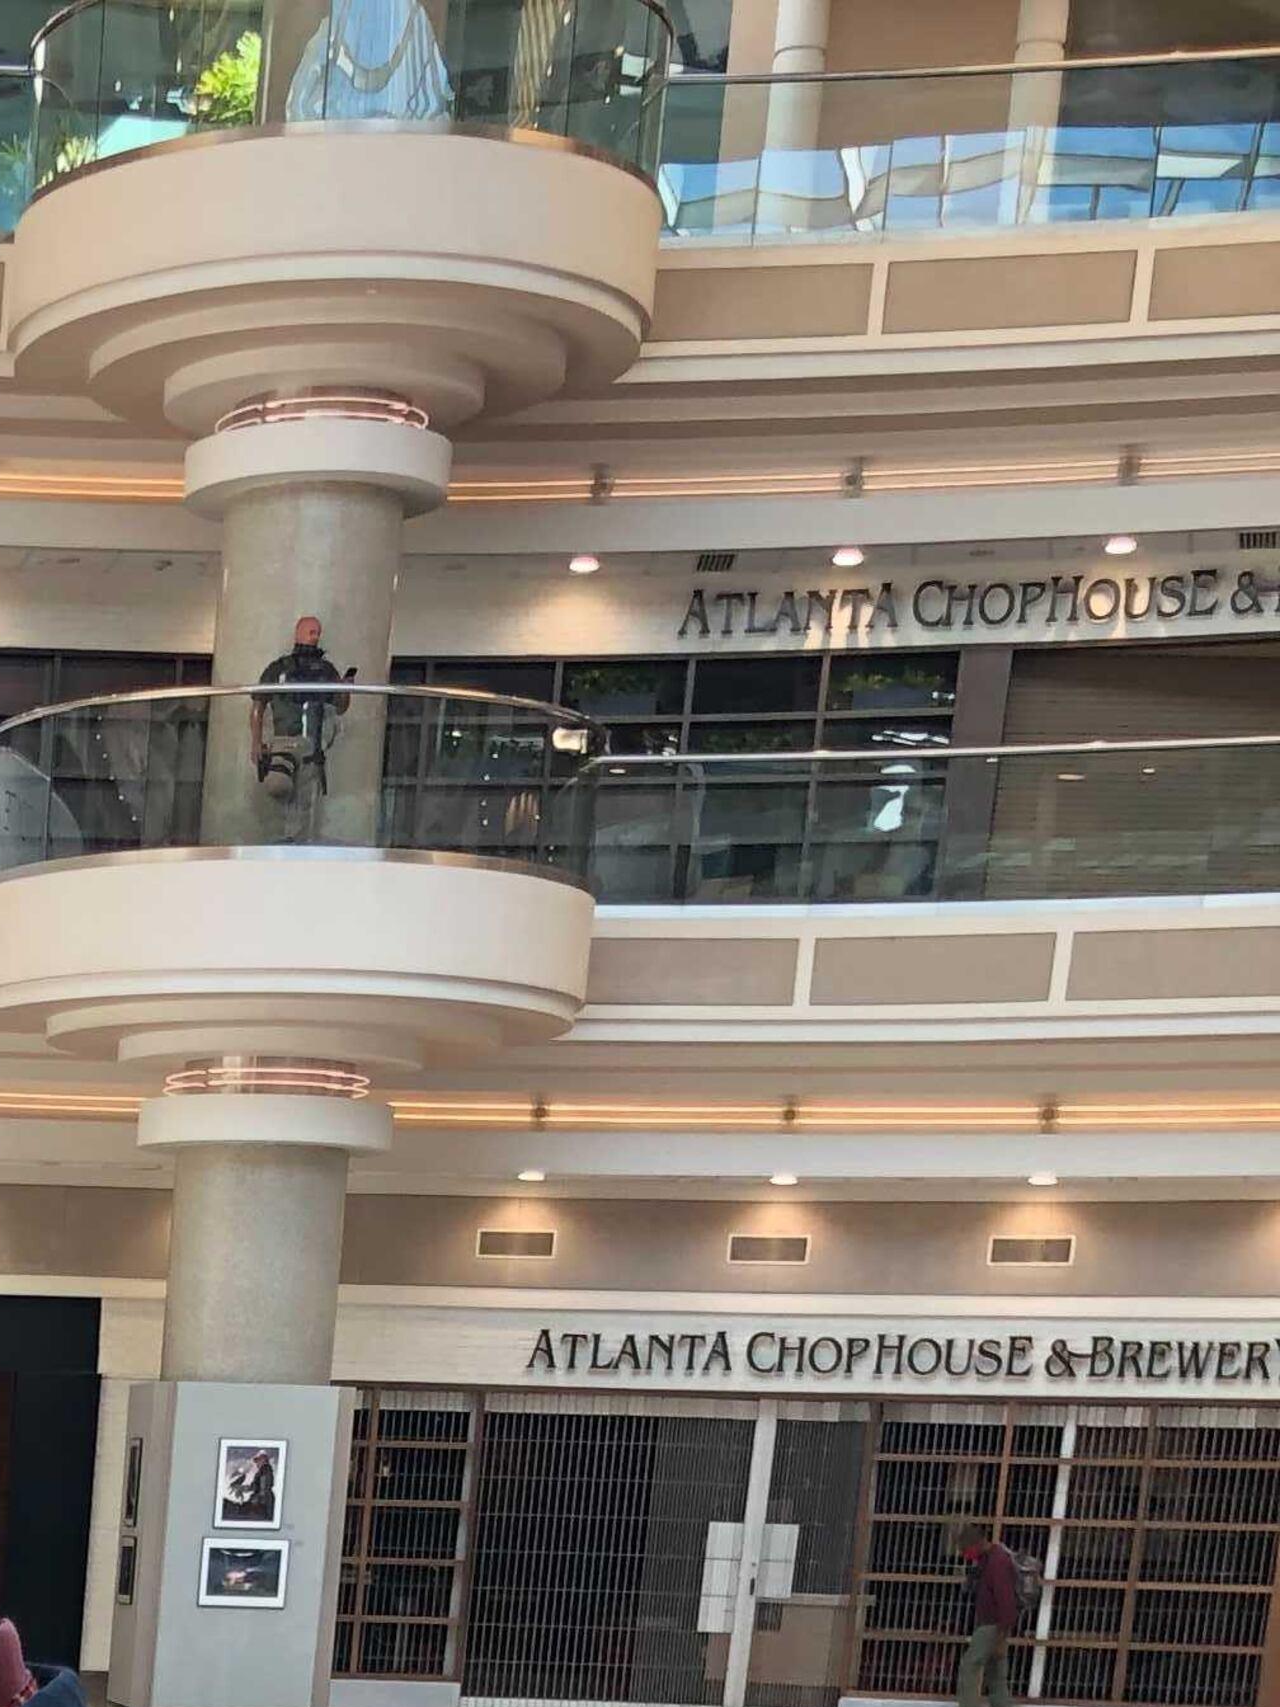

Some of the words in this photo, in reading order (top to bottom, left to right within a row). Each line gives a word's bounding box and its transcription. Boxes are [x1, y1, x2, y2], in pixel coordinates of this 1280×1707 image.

[678, 581, 899, 638] ATLANTA
[1230, 570, 1264, 615] &
[525, 1328, 734, 1376] ATLANTA
[745, 1331, 1035, 1381] CHOPHOUSE
[1044, 1337, 1078, 1380] &
[1085, 1333, 1280, 1382] BREWER
